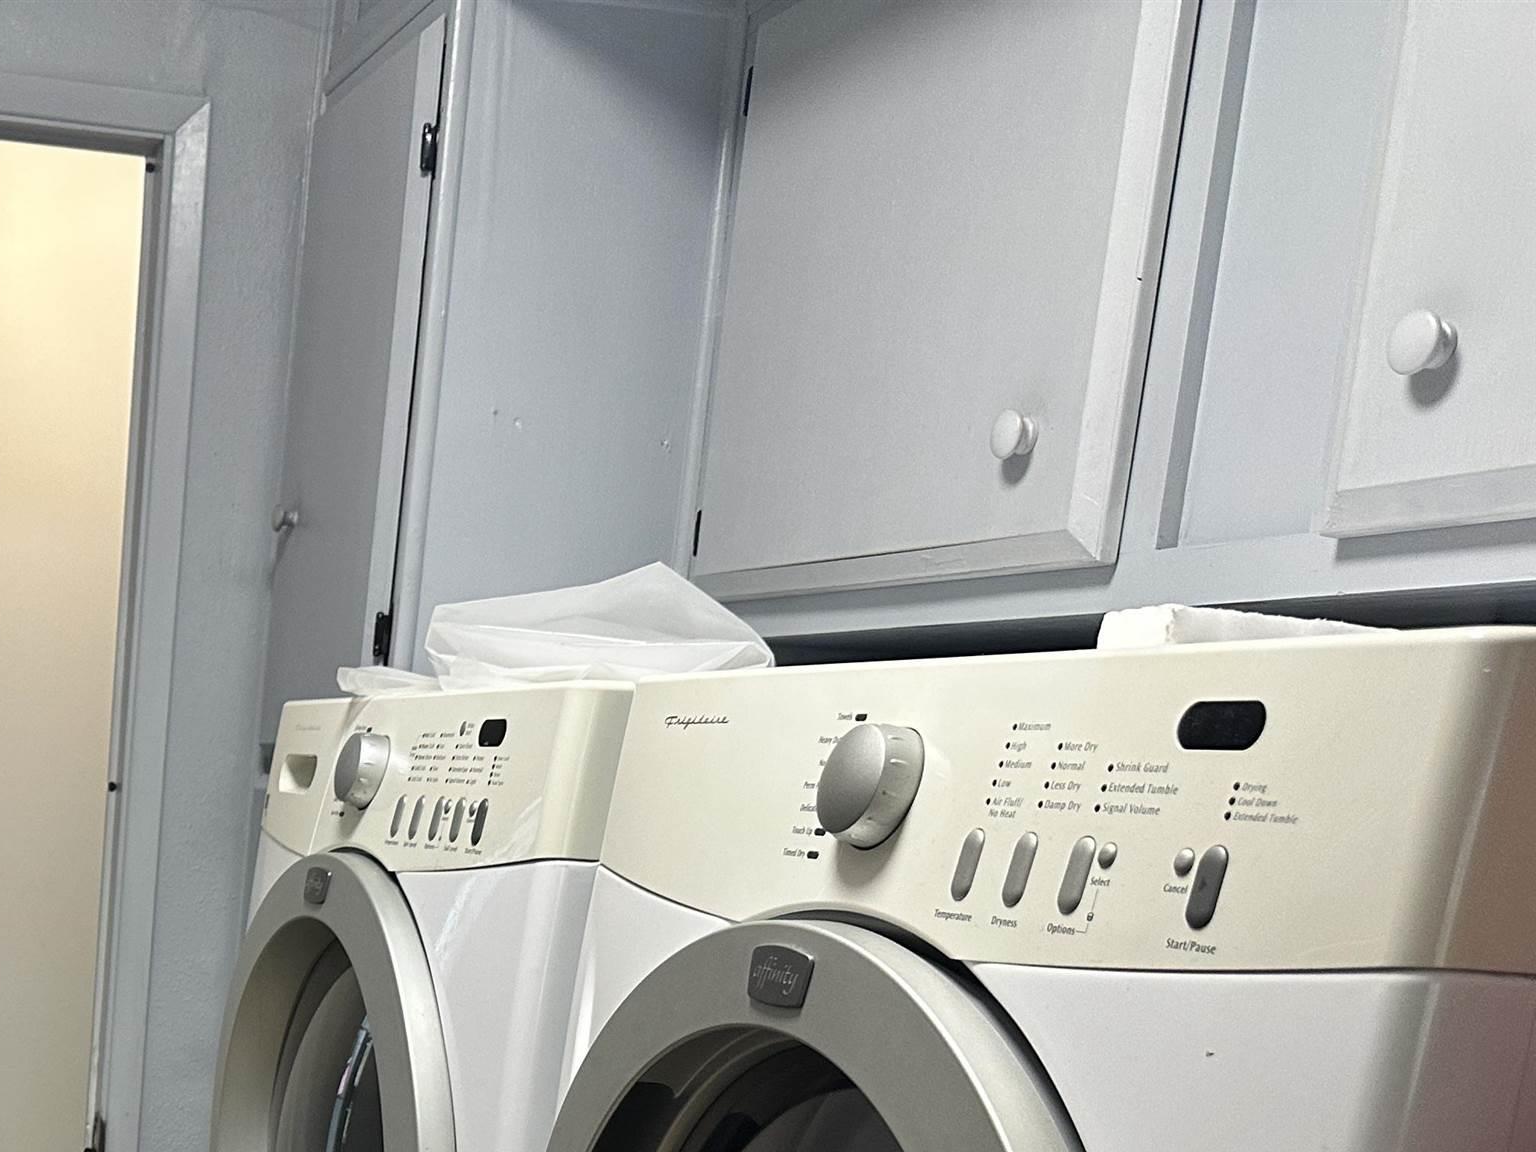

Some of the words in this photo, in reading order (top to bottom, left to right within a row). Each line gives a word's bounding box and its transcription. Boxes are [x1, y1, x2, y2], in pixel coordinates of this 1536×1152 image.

[664, 714, 730, 730] Frigidaire
[1018, 723, 1051, 731] Maximum
[1010, 741, 1027, 752] High
[1064, 742, 1082, 751] More
[1084, 742, 1098, 753] Dry
[1005, 760, 1032, 769] Medium
[1058, 761, 1086, 771] Normal
[1115, 762, 1141, 772] Shrink
[1143, 762, 1169, 773] Guard
[997, 779, 1011, 788] Low
[1051, 781, 1065, 790] Less
[1067, 781, 1081, 792] Dry
[1108, 782, 1145, 794] Extended
[1147, 783, 1178, 795] Tumble
[1241, 783, 1267, 794] Drying
[991, 798, 1002, 807] Air
[1044, 799, 1066, 811] Damp
[1067, 800, 1081, 811] Dry
[1238, 798, 1254, 807] Cool
[1256, 798, 1277, 807] Down
[988, 809, 998, 817] No
[1000, 809, 1016, 818] Heat
[1103, 803, 1126, 815] Signal
[1129, 804, 1160, 816] Volume
[1233, 812, 1266, 823] Extended
[1269, 813, 1298, 824] Tumble
[1090, 876, 1111, 887] Select
[1163, 883, 1189, 895] Cancel
[934, 908, 972, 923] Temperature
[991, 915, 1018, 929] Dryness
[1046, 923, 1076, 936] Options
[1166, 937, 1217, 955] Start/Pause
[752, 956, 800, 996] affinity
